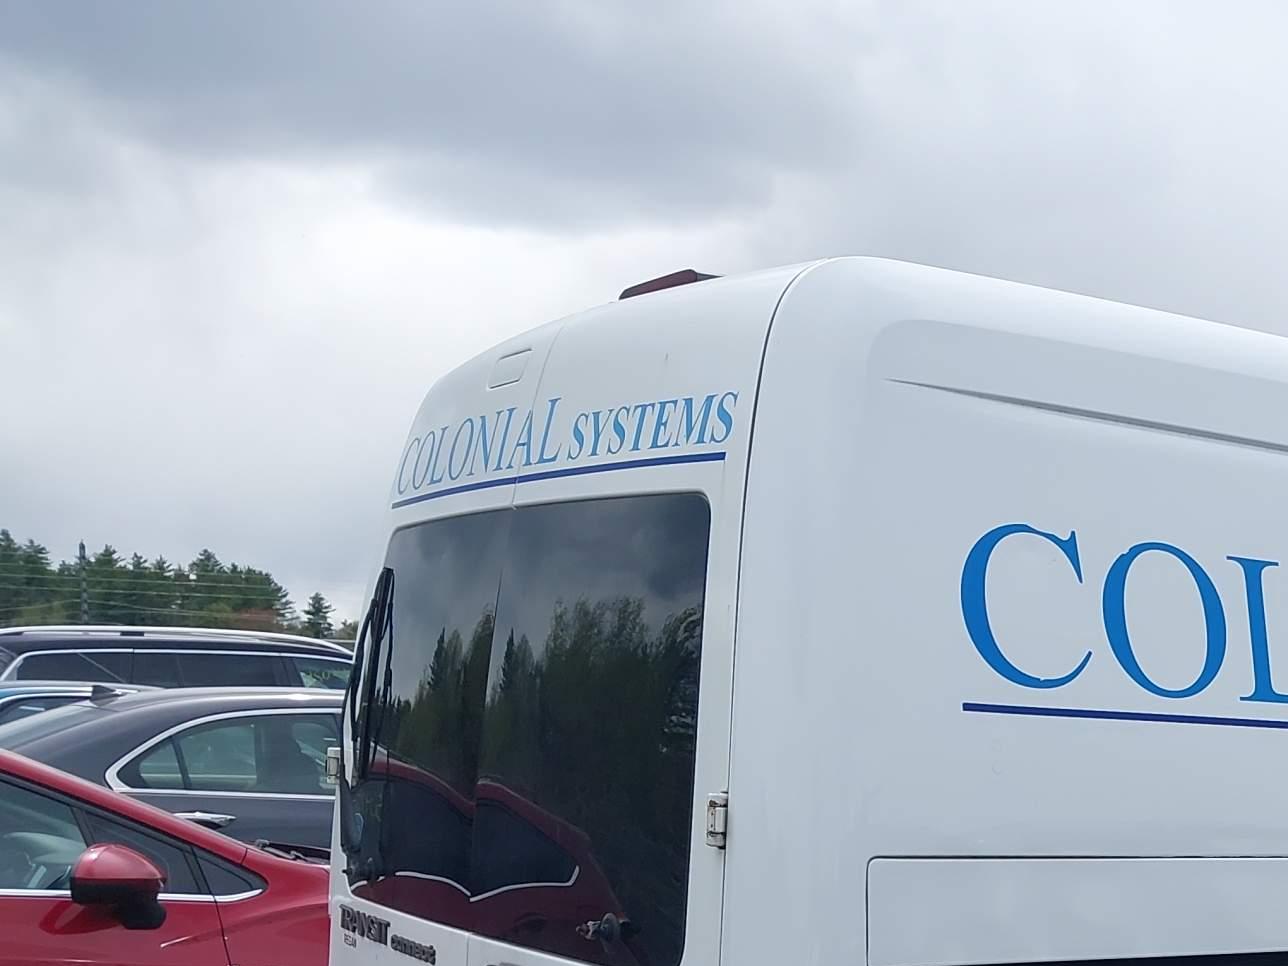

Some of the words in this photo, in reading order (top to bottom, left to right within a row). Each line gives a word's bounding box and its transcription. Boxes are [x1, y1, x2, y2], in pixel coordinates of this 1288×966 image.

[396, 397, 562, 495] COLONIAL
[567, 391, 739, 460] SYSTEMS
[339, 903, 391, 947] TRANSIT
